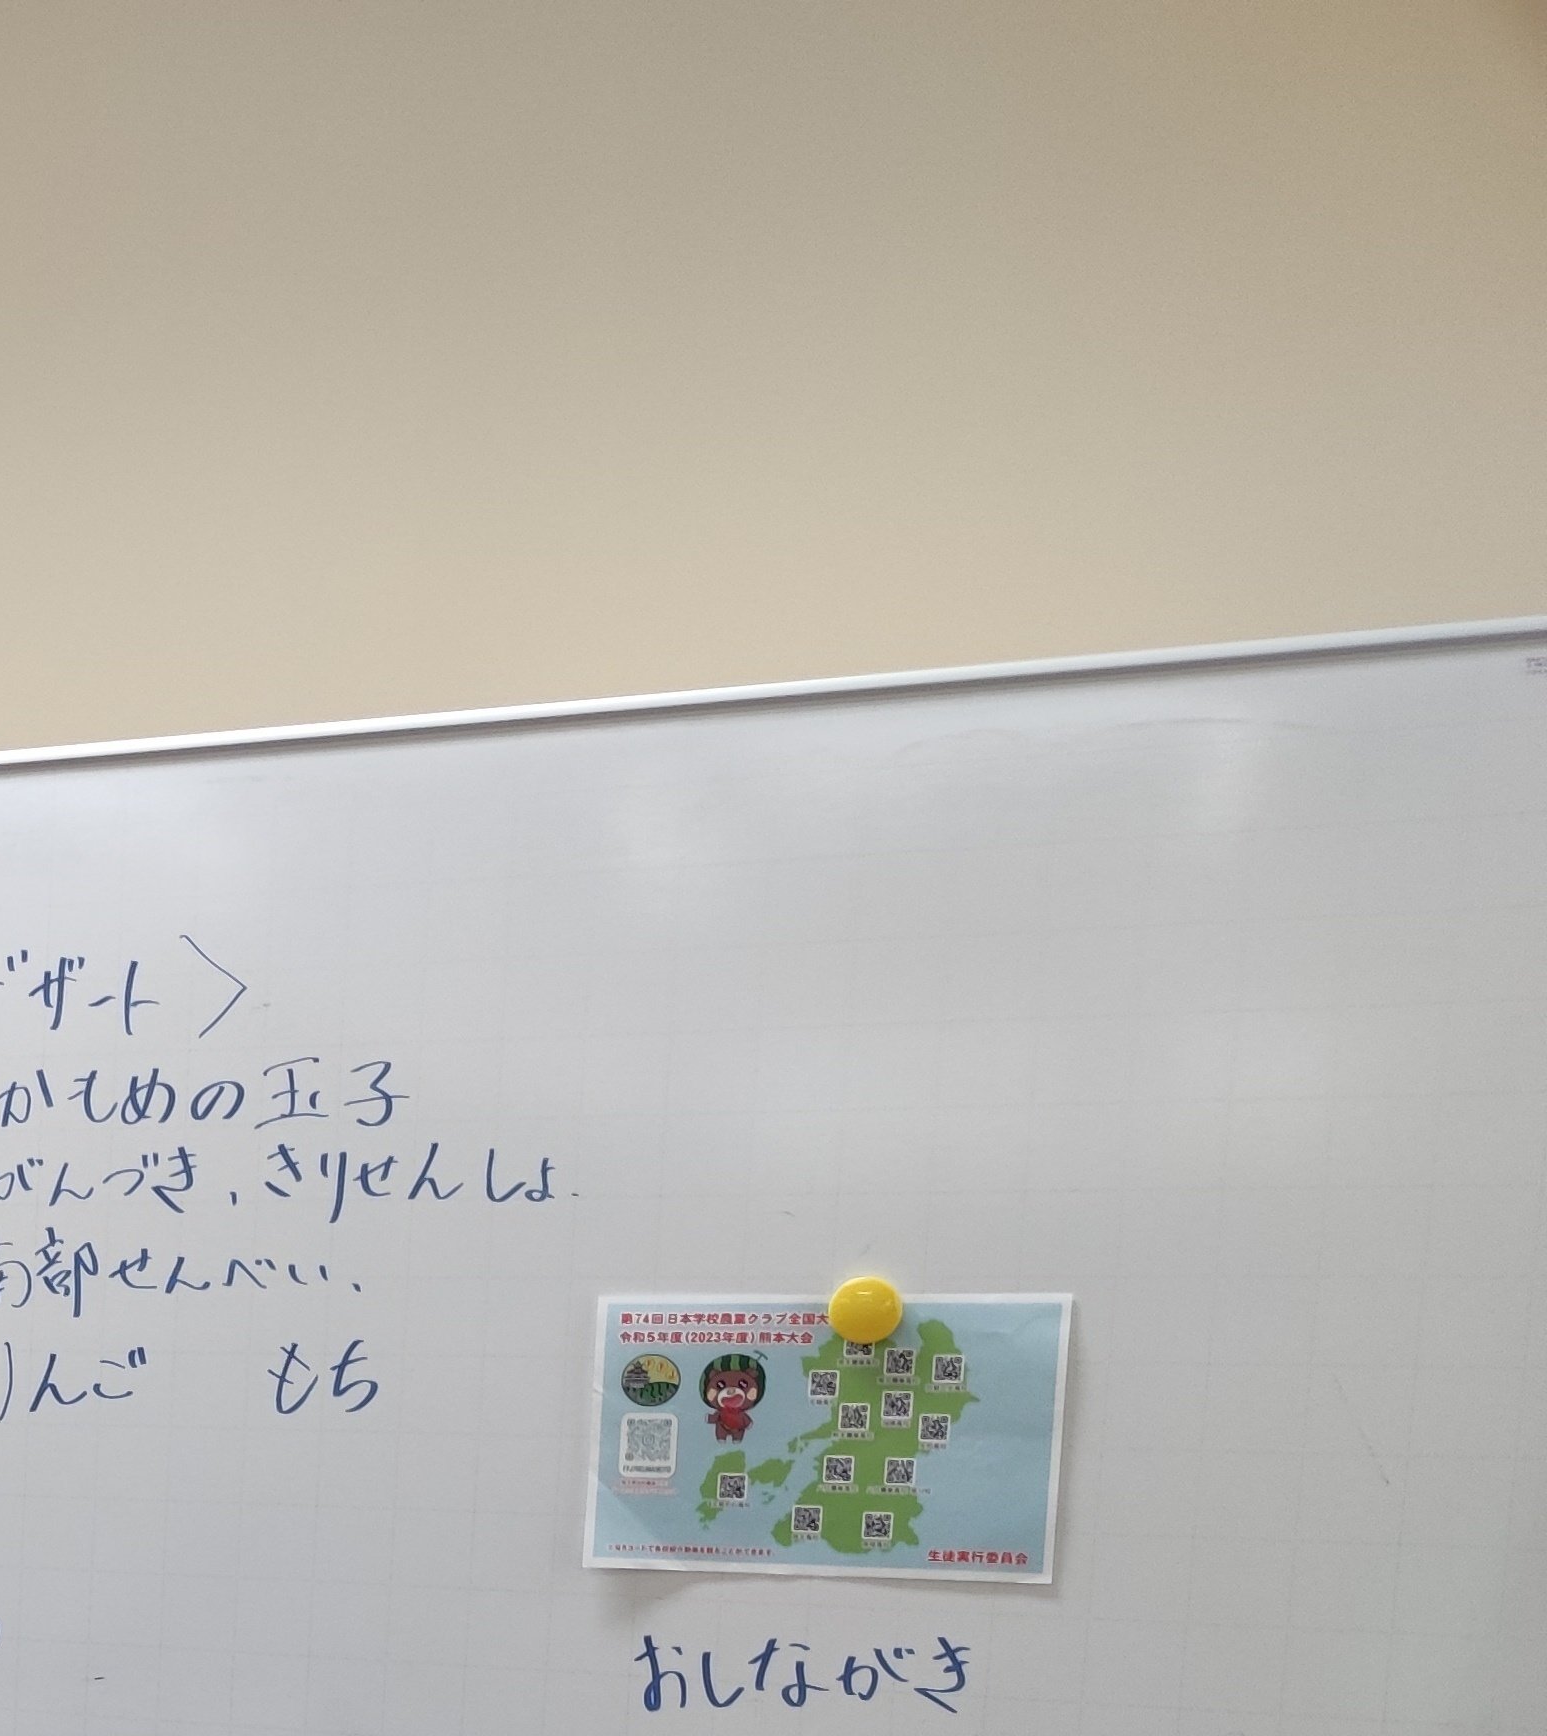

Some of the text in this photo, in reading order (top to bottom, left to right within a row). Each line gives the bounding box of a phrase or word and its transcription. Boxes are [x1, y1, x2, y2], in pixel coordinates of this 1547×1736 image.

[267, 1338, 382, 1416] もち
[927, 1550, 1029, 1566] 生徒実行委員会
[634, 1634, 973, 1716] おしながき
